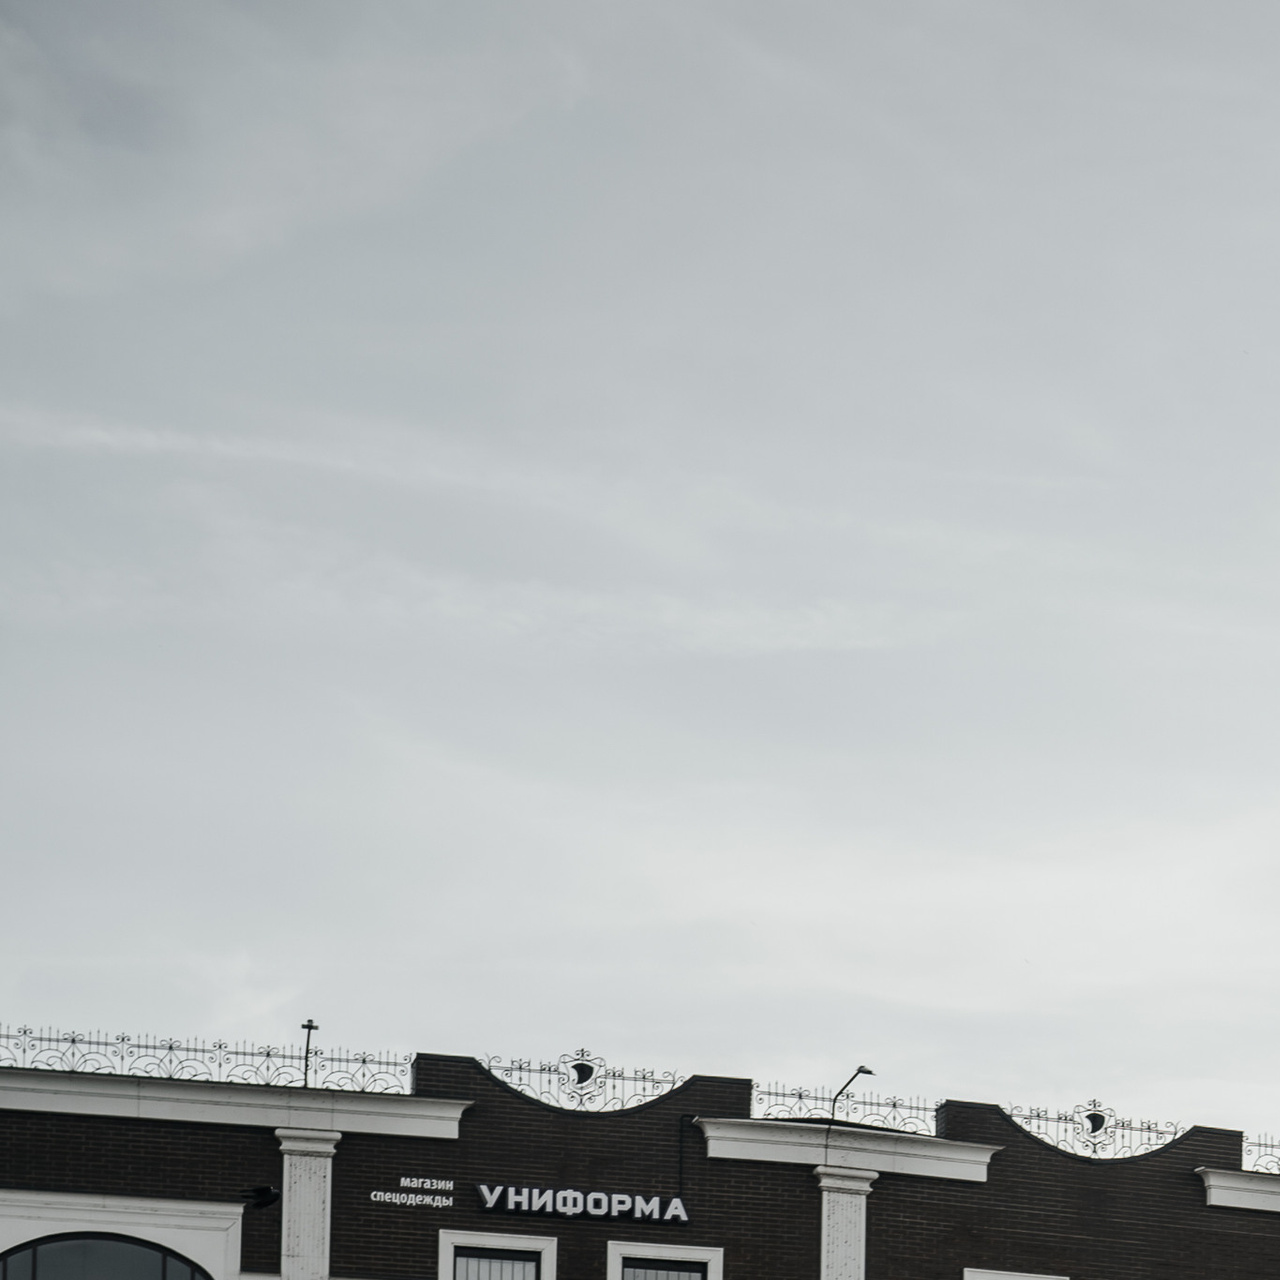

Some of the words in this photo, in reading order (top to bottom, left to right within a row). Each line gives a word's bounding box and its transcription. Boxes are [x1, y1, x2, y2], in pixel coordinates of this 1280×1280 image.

[400, 1176, 454, 1190] магазин
[370, 1189, 454, 1208] спецодежды
[479, 1184, 689, 1222] УНИФОРМА
